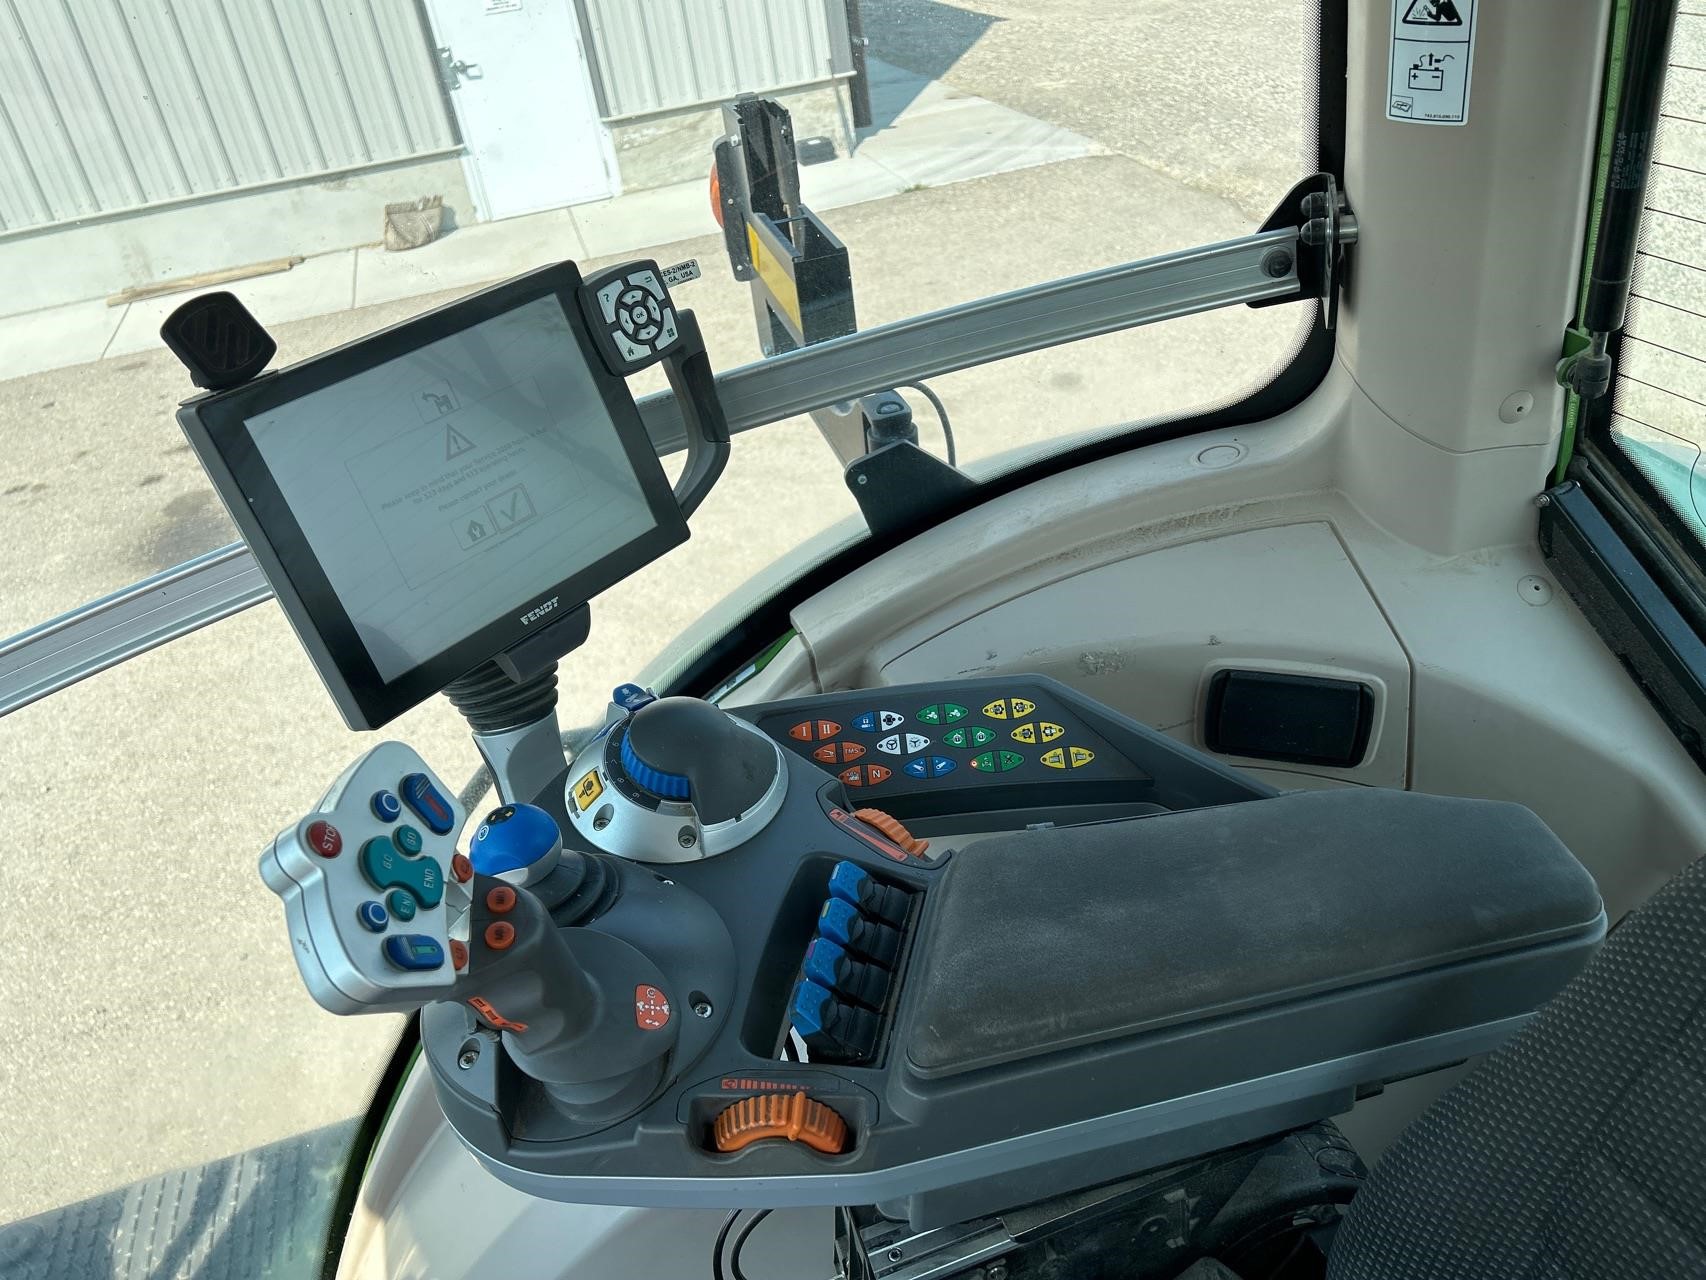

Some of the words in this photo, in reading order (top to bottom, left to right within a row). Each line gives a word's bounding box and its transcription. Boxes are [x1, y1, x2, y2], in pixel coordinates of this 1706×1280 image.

[680, 269, 694, 278] USA
[520, 596, 558, 625] FENDT
[872, 769, 881, 778] N
[407, 832, 417, 846] GO
[383, 855, 393, 870] GO
[423, 868, 435, 889] END
[400, 892, 412, 914] END
